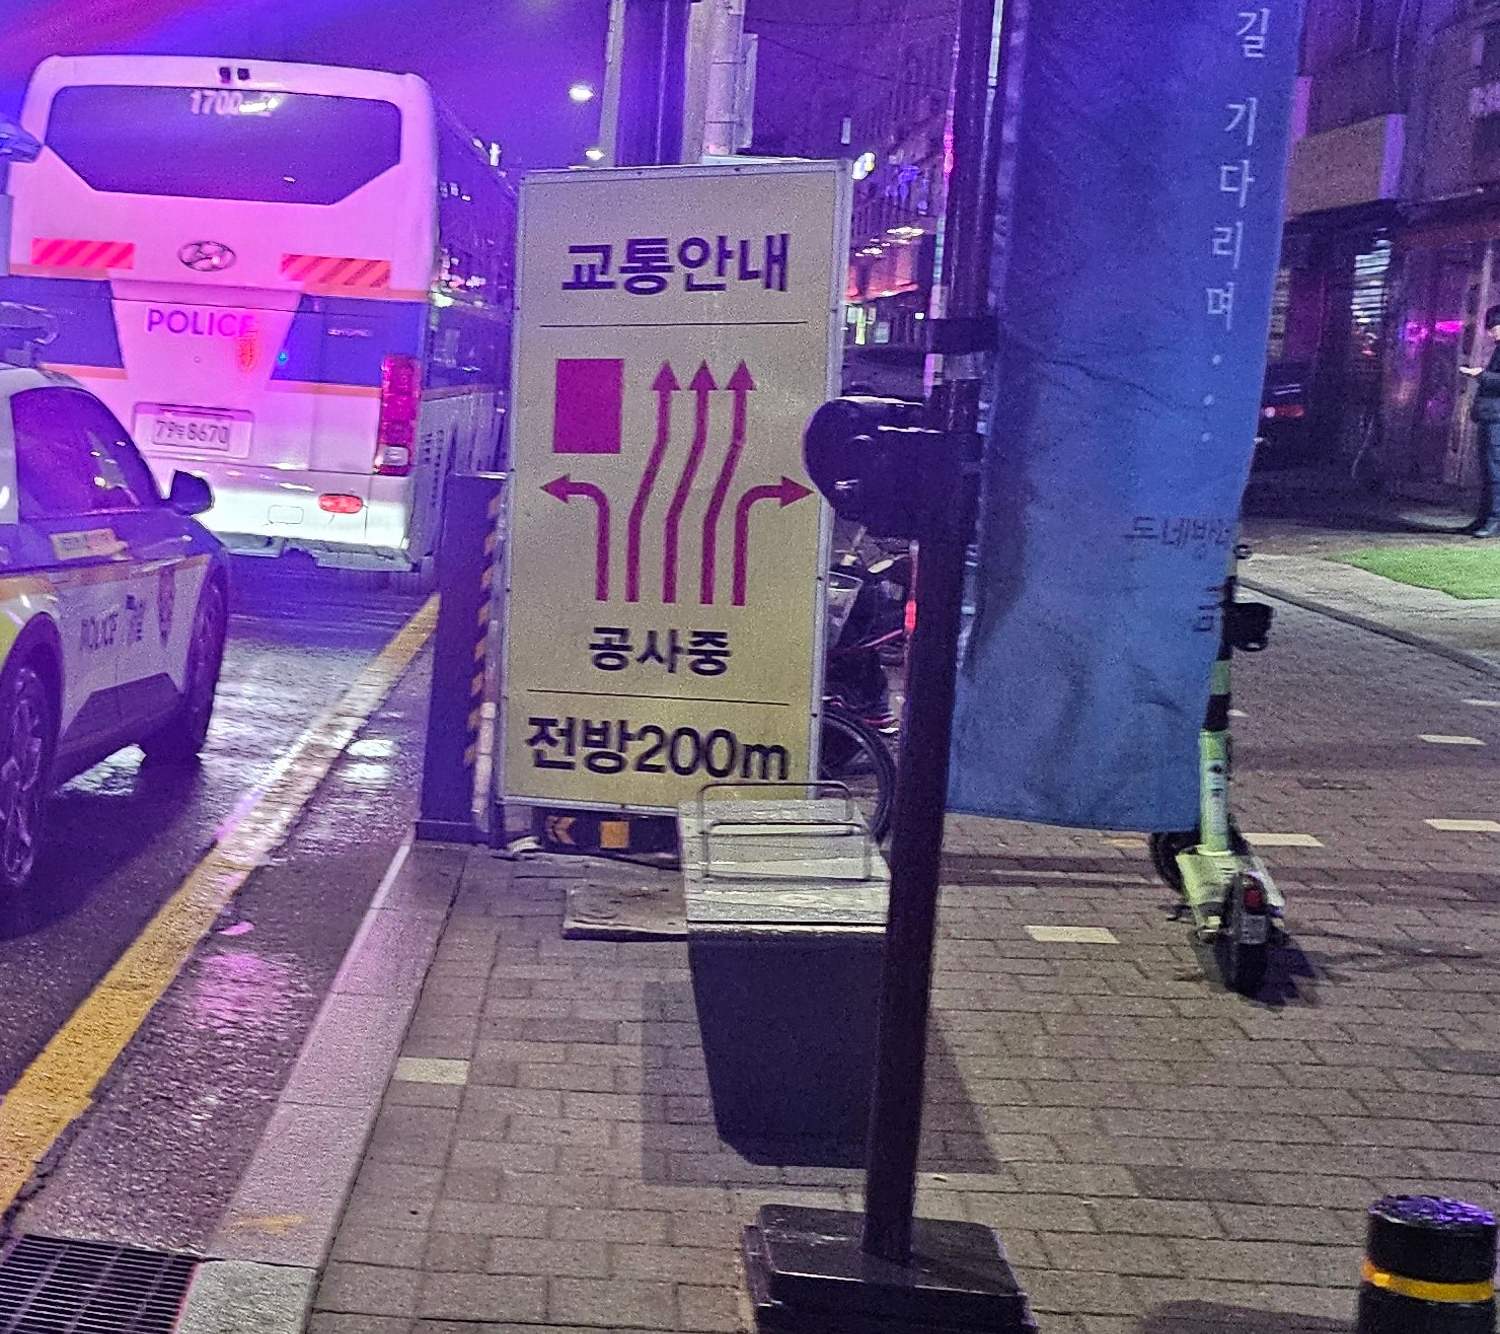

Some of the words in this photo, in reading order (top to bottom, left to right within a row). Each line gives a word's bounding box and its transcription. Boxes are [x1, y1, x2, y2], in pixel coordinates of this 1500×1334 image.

[560, 233, 791, 296] 교통안내
[146, 307, 258, 338] POLICE
[587, 625, 733, 677] 공사중
[524, 716, 790, 781] 전방200m
